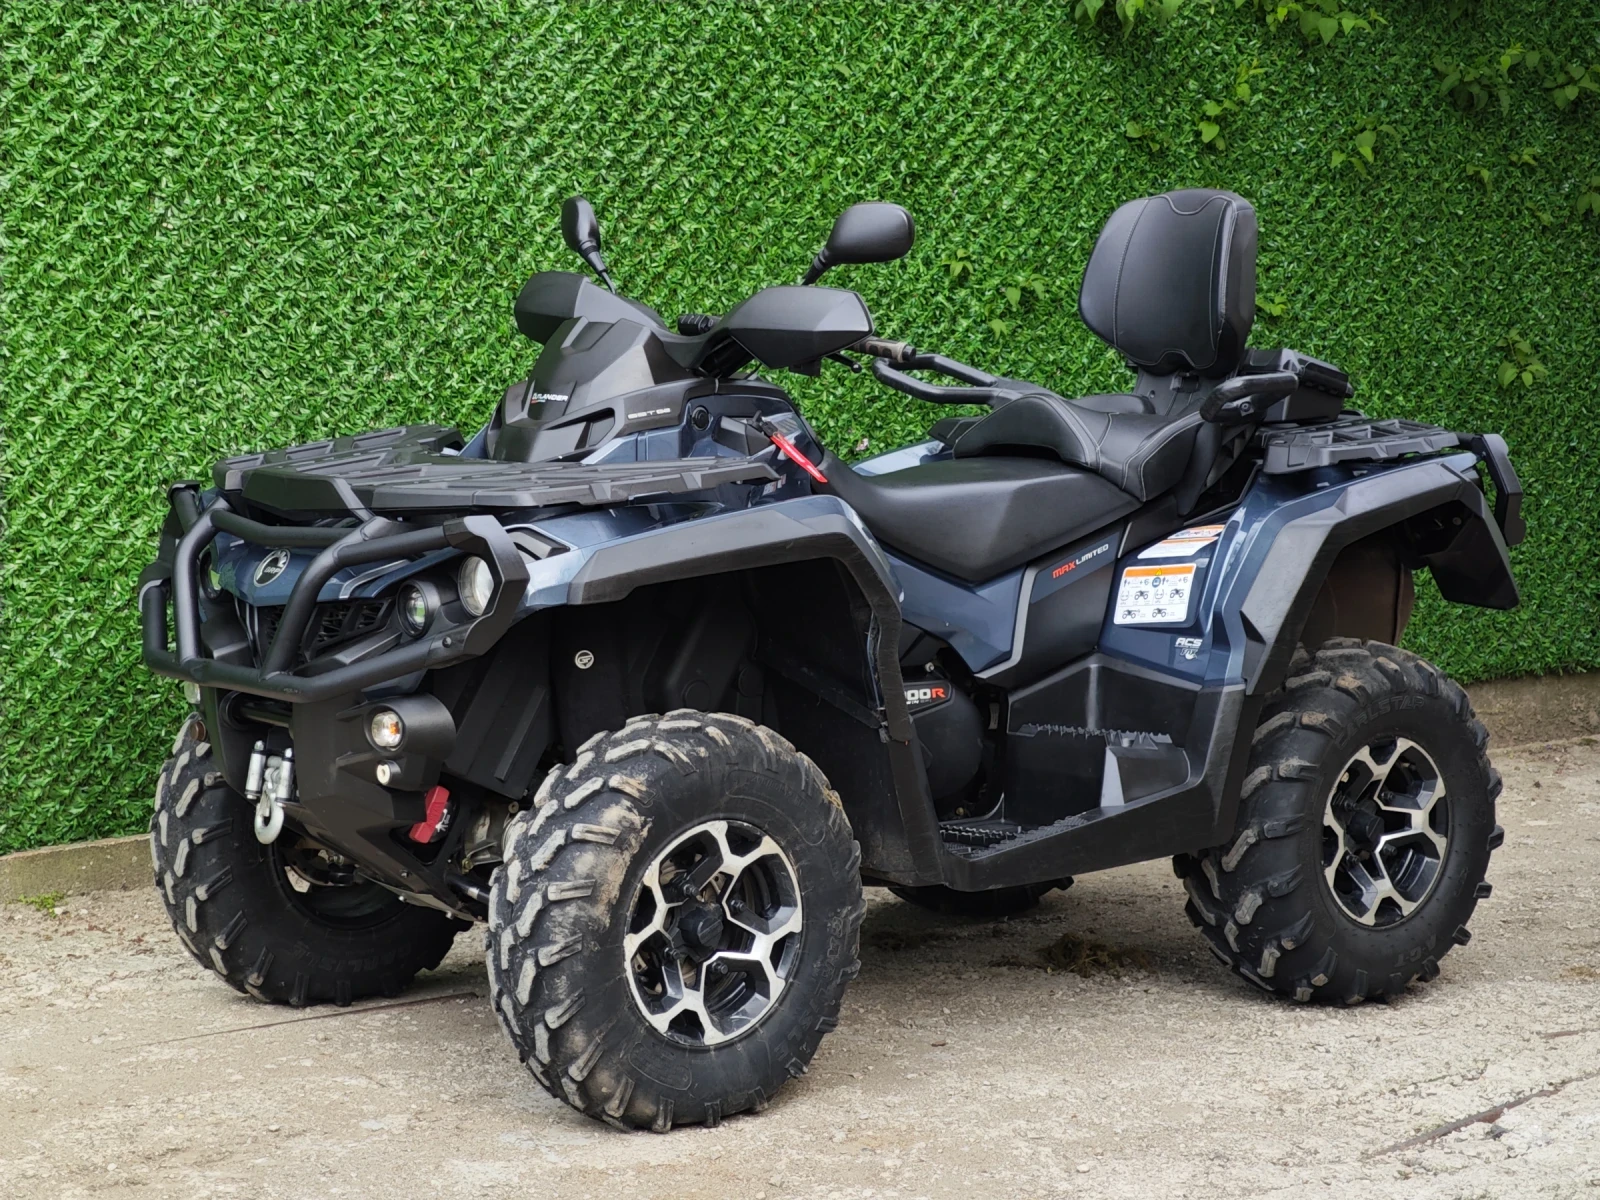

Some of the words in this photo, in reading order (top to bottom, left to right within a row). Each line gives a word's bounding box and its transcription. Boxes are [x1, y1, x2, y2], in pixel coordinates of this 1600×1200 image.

[1052, 560, 1076, 579] MAX
[1075, 543, 1109, 565] LIMITED
[1175, 637, 1203, 647] ACS
